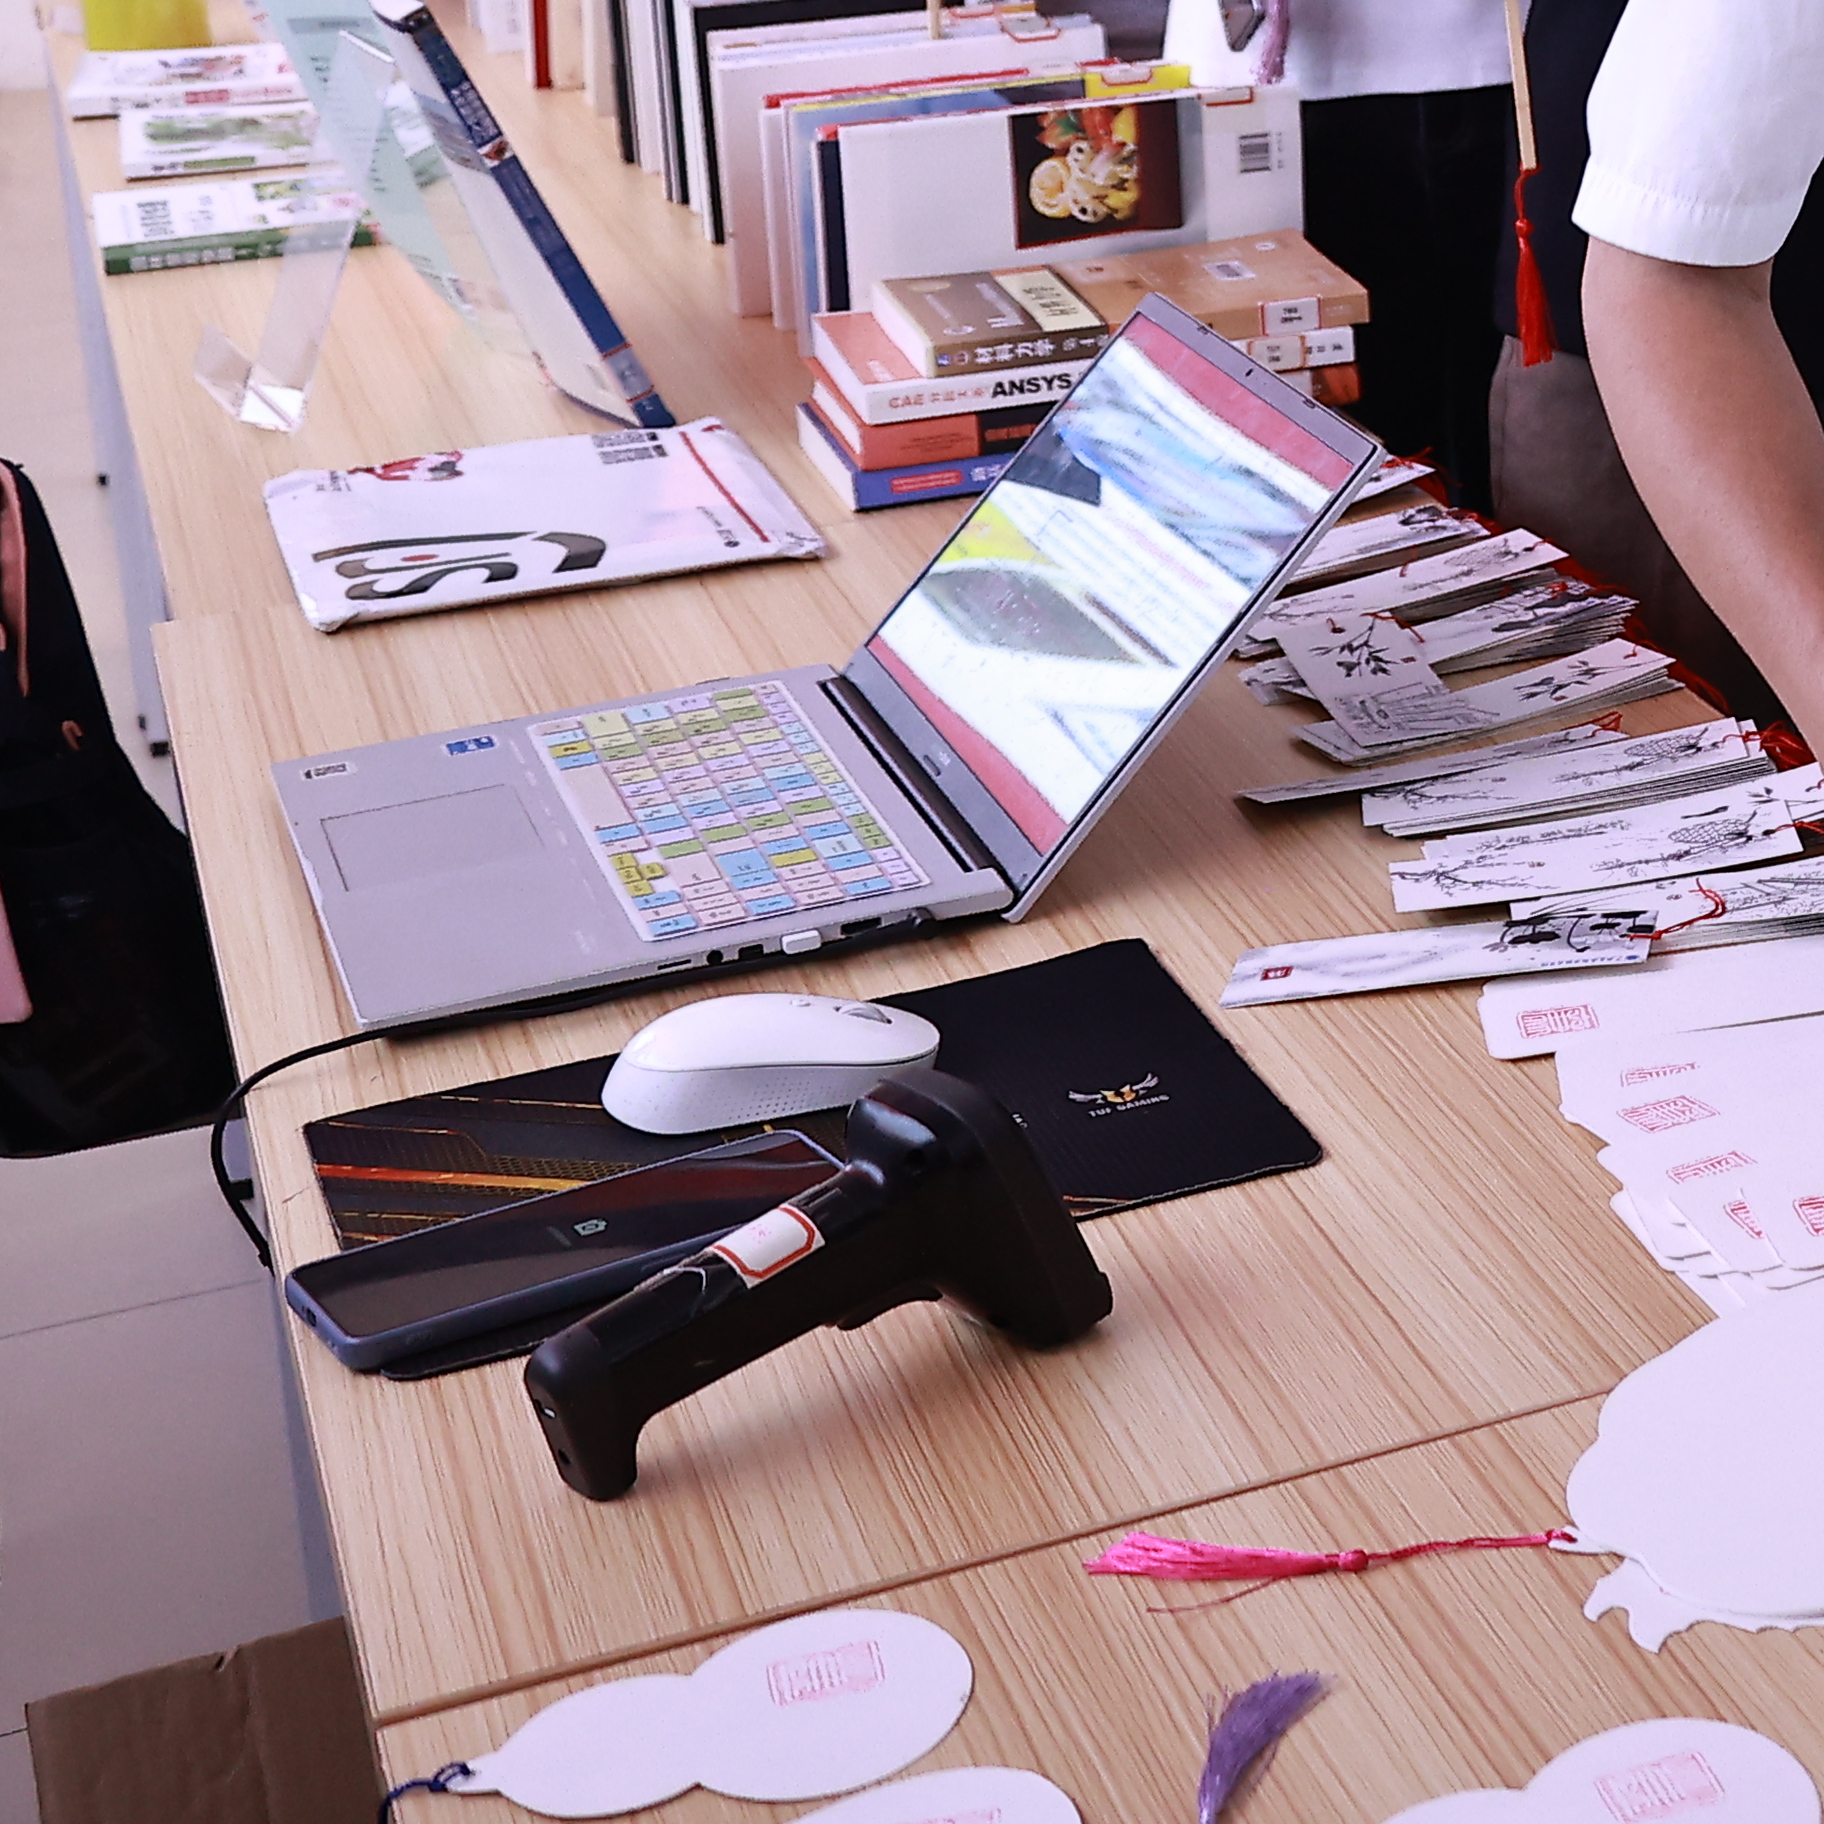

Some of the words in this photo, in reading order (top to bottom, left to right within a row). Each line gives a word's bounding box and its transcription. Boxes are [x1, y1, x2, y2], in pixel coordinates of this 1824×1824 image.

[991, 373, 1073, 399] ANSYS
[1088, 1107, 1112, 1118] TUF
[1116, 1095, 1170, 1111] GAMING
